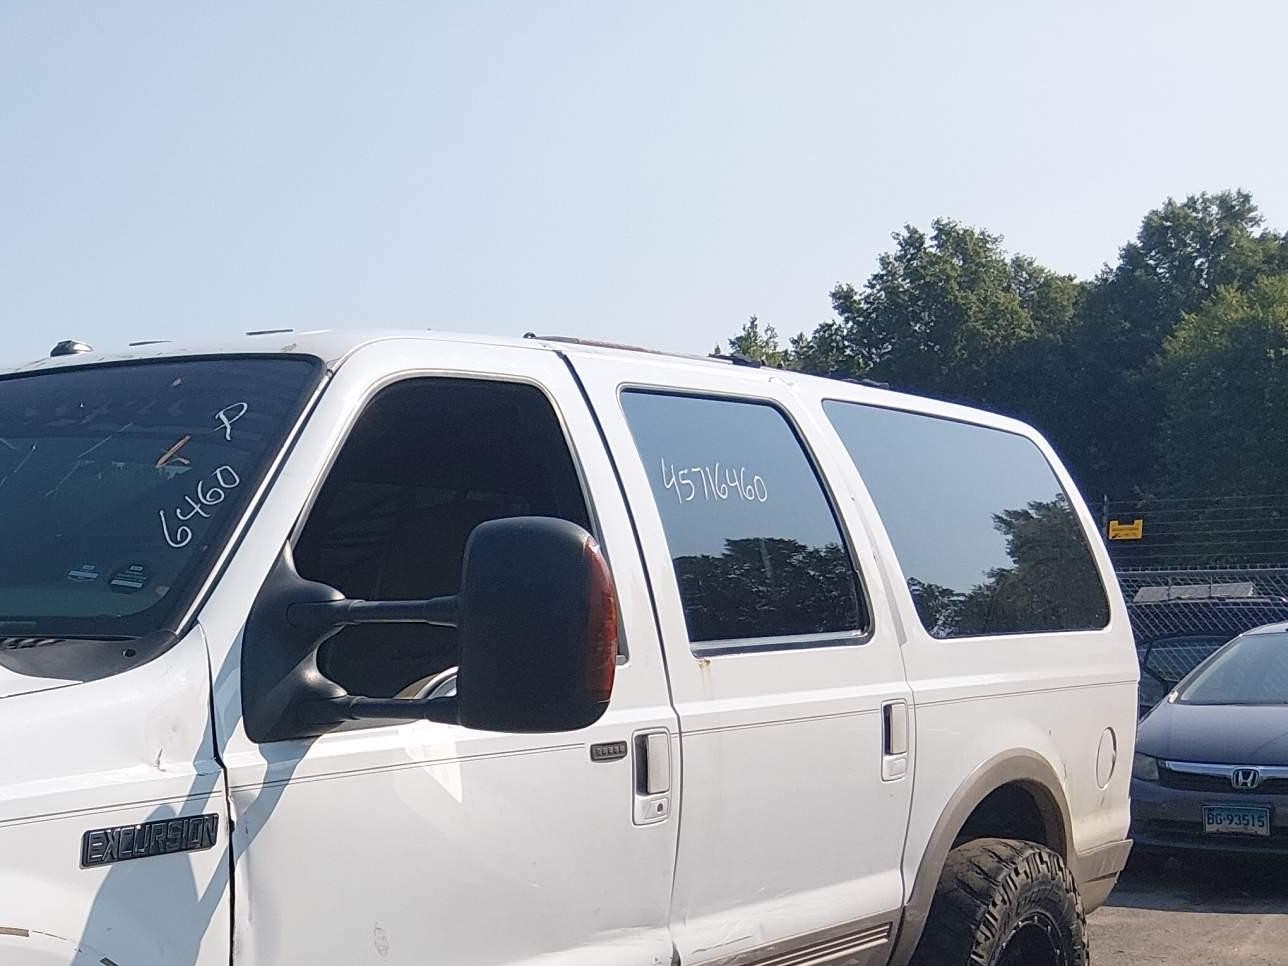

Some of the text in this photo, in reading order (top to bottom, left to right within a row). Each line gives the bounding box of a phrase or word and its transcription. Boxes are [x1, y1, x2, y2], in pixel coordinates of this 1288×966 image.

[661, 457, 768, 504] 45716460
[160, 466, 240, 547] 6460
[87, 815, 218, 863] EXCURSION
